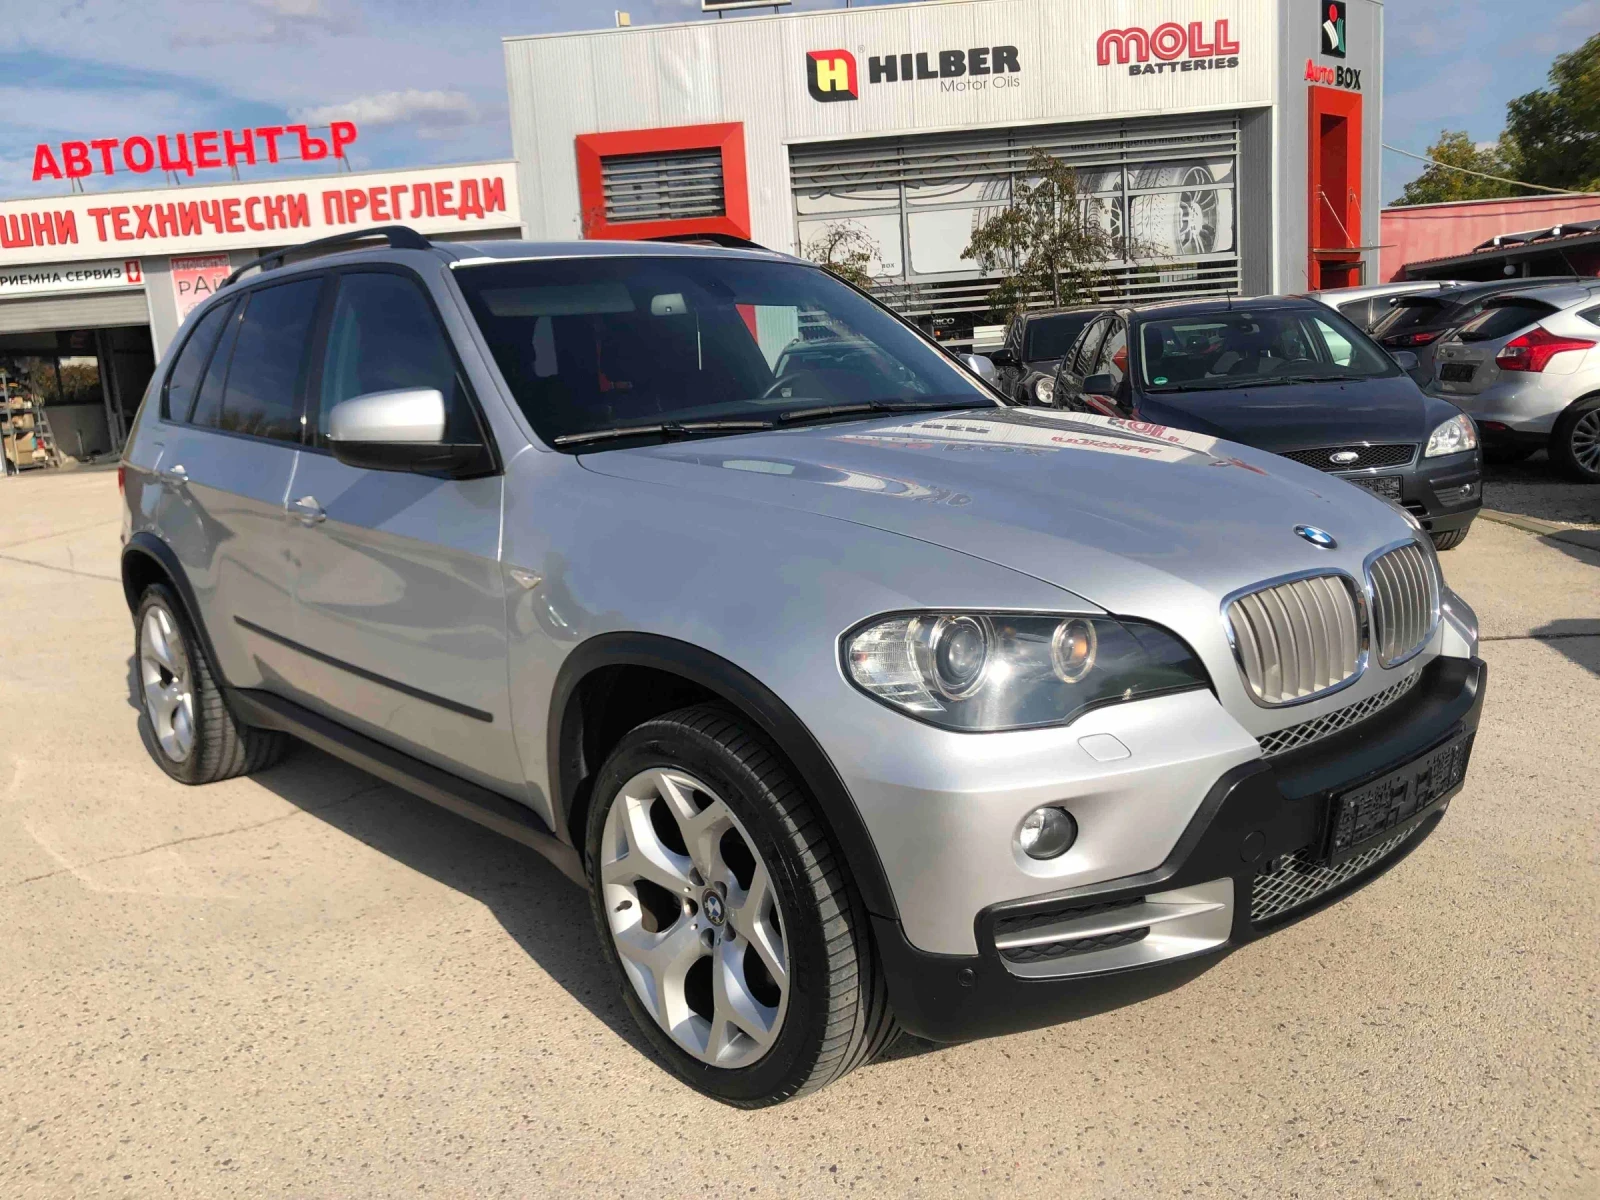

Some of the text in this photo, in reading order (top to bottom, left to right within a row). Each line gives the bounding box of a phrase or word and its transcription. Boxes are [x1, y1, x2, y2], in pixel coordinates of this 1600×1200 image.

[1096, 18, 1240, 66] MOLL
[868, 45, 1021, 84] HILBER
[1128, 56, 1240, 76] BATTERIES
[940, 76, 1021, 93] Motor Oils
[31, 120, 358, 181] АВТОЦЕНТЪР
[0, 177, 507, 249] ШНИ ТЕХНИЧЕСКИ ПРЕГЛЕДИ
[65, 267, 122, 282] СЕРВИЗ
